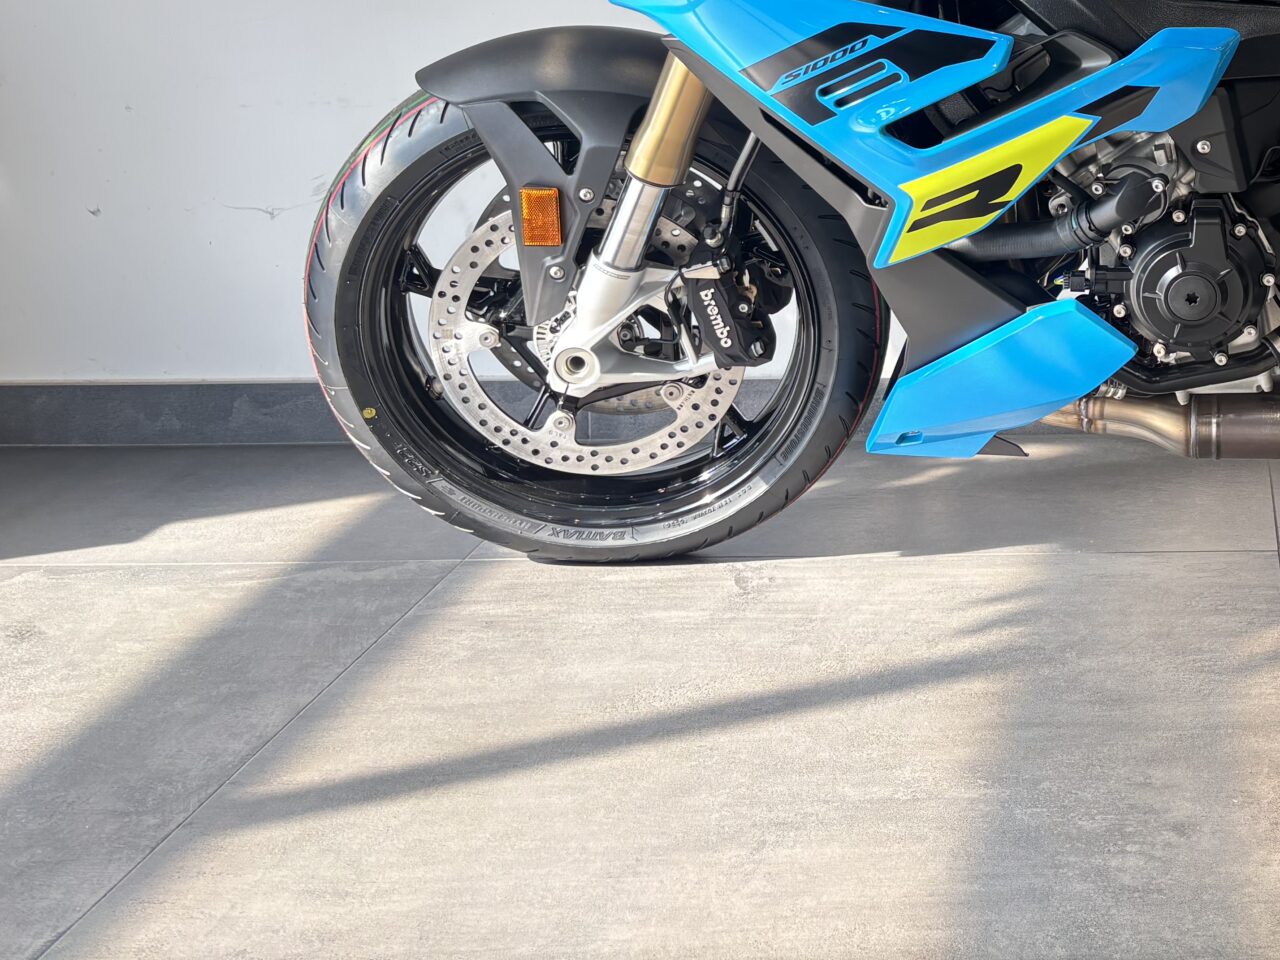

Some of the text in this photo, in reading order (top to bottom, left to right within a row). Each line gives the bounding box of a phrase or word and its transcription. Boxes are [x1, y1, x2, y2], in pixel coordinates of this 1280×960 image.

[781, 38, 869, 86] S1000
[906, 163, 1023, 234] R
[699, 288, 732, 348] brembo
[548, 526, 627, 541] BATTLAX
